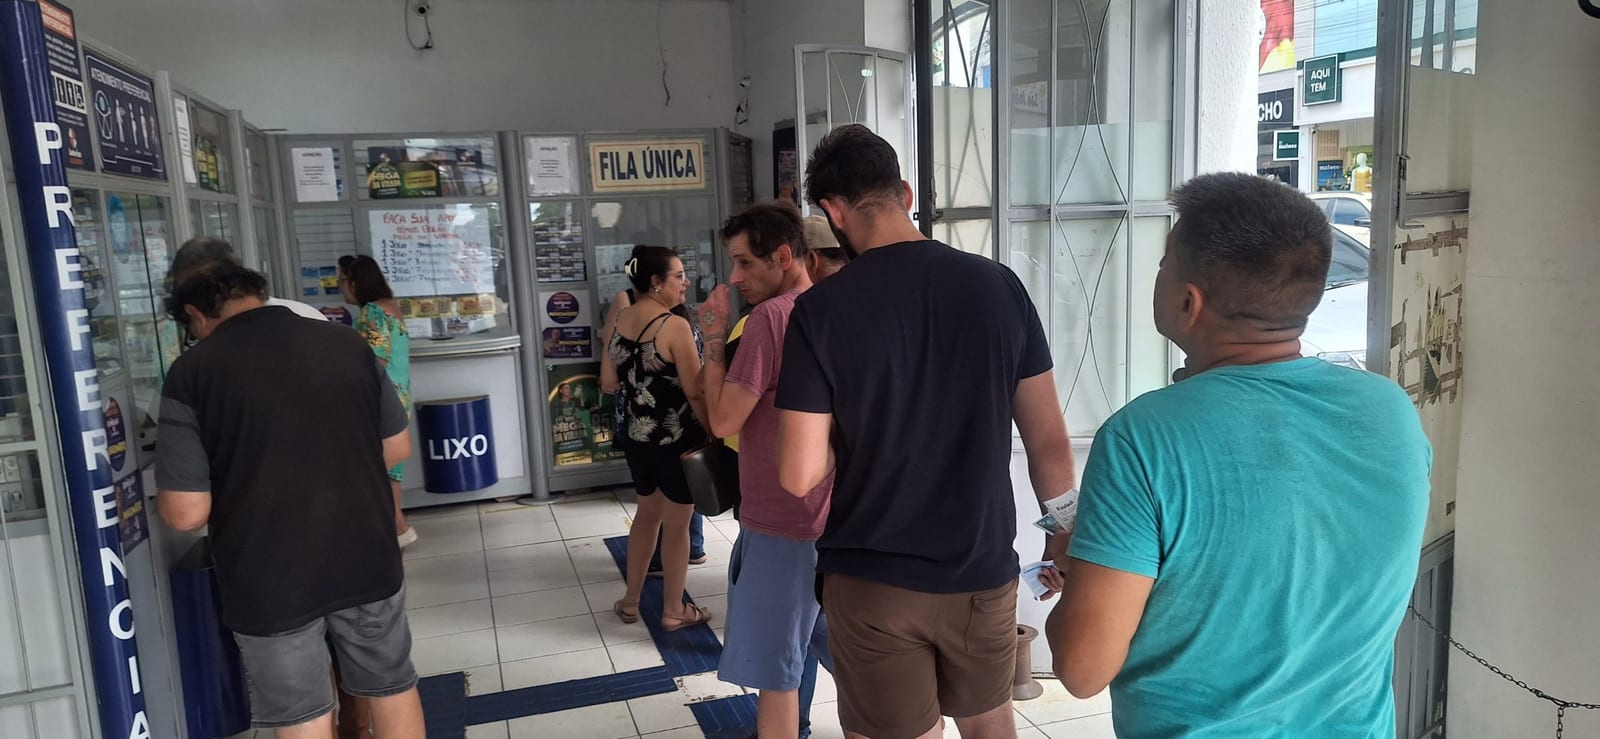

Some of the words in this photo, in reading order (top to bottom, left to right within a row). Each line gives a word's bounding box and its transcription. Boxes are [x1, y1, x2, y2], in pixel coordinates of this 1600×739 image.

[1310, 67, 1330, 80] AQUI
[1310, 81, 1327, 93] TEM
[598, 151, 639, 181] FILA
[641, 145, 697, 179] ÚNICA
[428, 433, 488, 460] LIXO
